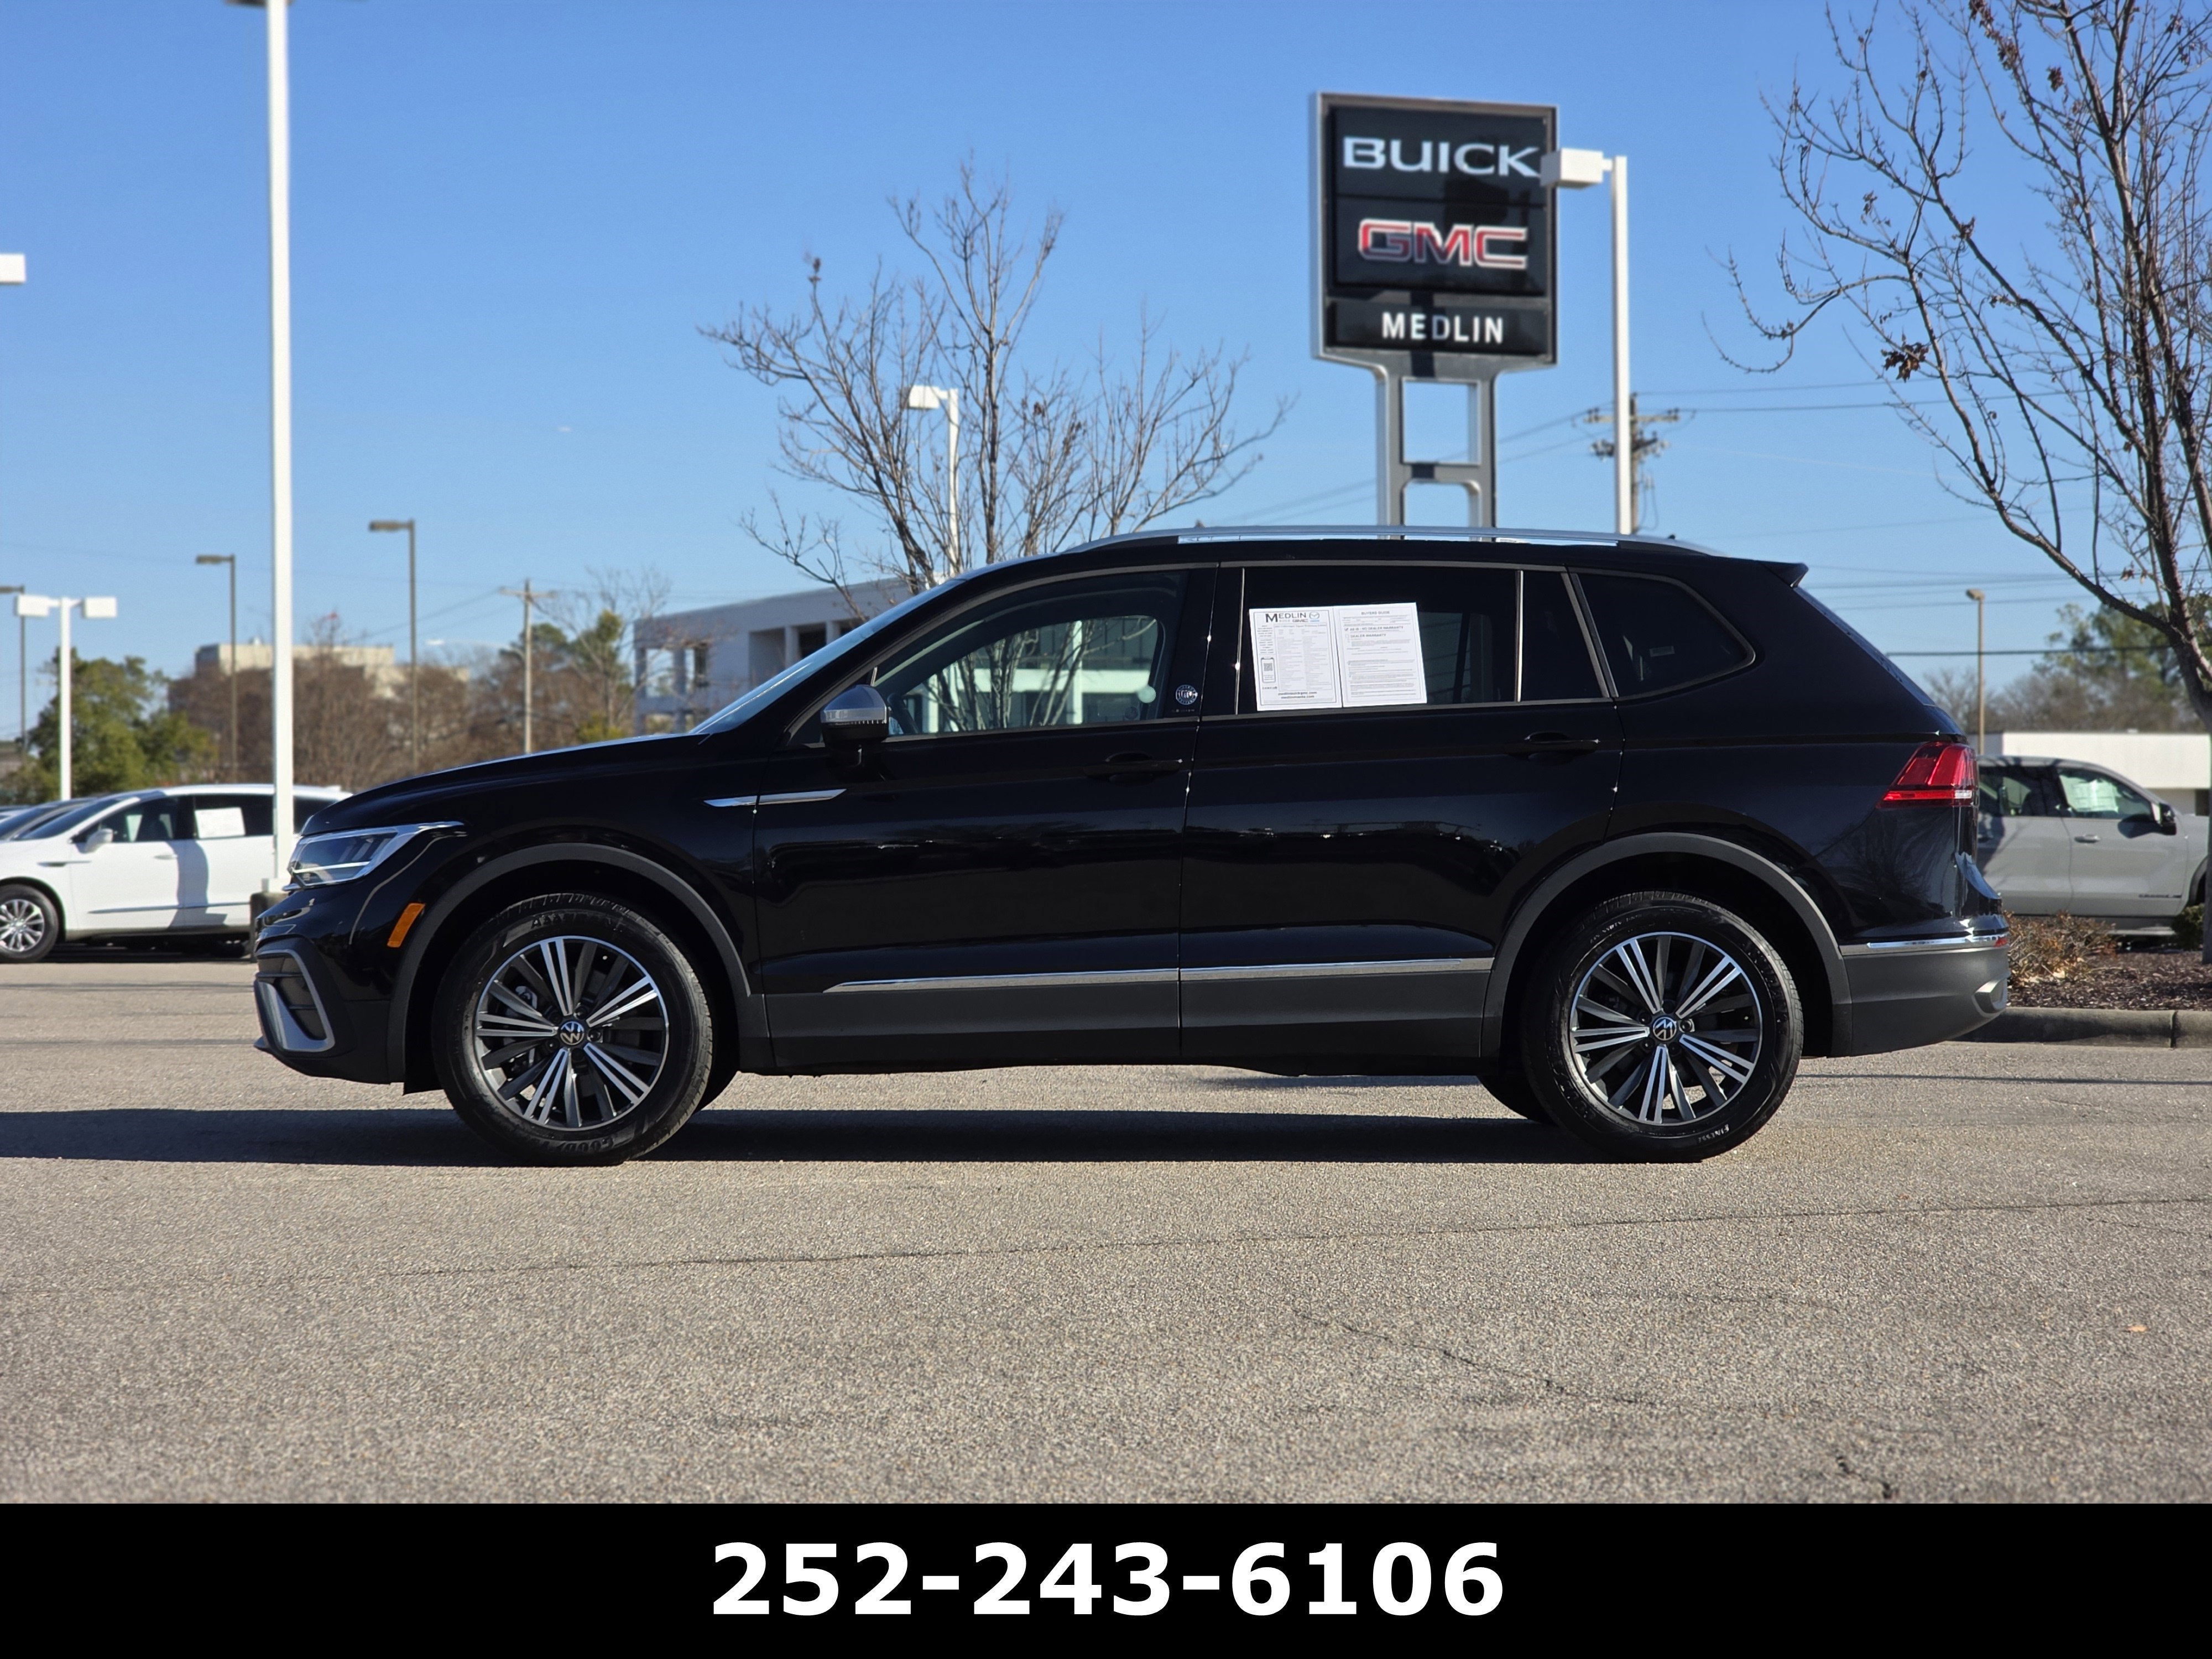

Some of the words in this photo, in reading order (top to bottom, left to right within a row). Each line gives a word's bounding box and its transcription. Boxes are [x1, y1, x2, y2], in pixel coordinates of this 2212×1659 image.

[1343, 136, 1541, 178] BUICK
[1358, 218, 1528, 270] GMC
[1381, 311, 1503, 344] MEDLIN
[1265, 612, 1306, 623] MEDLIN
